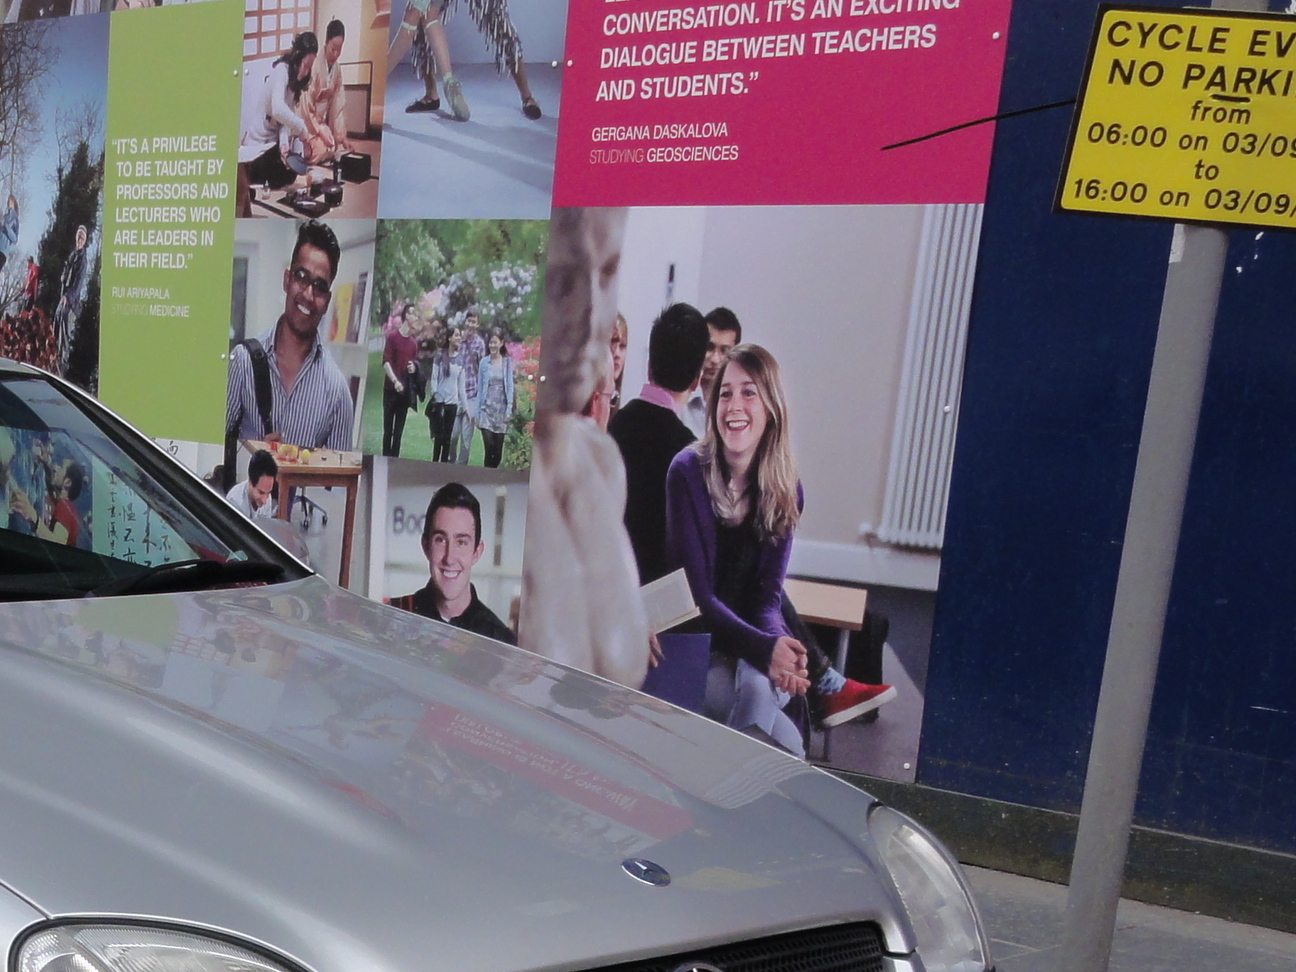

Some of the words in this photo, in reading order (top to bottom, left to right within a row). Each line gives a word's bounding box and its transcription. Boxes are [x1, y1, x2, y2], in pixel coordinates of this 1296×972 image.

[603, 5, 760, 37] CONVERSATION.
[810, 0, 842, 19] AN
[600, 40, 697, 70] DIALOGUE
[702, 33, 805, 63] BETWEEN
[812, 24, 937, 55] TEACHERS
[1107, 20, 1231, 54] CYCLE
[1107, 58, 1164, 87] NO
[595, 79, 636, 102] AND
[640, 71, 759, 100] STUDENTS.”
[1190, 100, 1251, 125] from
[591, 125, 650, 142] GERGANA
[653, 122, 728, 140] DASKALOVA
[1087, 122, 1167, 148] 06:00
[1178, 134, 1208, 152] on
[140, 137, 149, 154] A
[152, 135, 217, 153] PRIVILEGE
[589, 148, 644, 164] STUDYING
[646, 145, 739, 163] GEOSCIENCES
[116, 161, 132, 177] TO
[135, 160, 152, 177] BE
[154, 159, 204, 176] TAUGHT
[207, 158, 224, 175] BY
[1194, 159, 1219, 181] to
[116, 183, 198, 200] PROFESSORS
[201, 182, 229, 199] AND
[1074, 178, 1148, 203] 16:00
[1159, 189, 1190, 207] on
[115, 206, 186, 223] LECTURERS
[190, 206, 221, 223] WHO
[114, 229, 138, 246] ARE
[141, 230, 198, 246] LEADERS
[201, 230, 214, 246] IN
[113, 252, 148, 268] THEIR
[151, 253, 193, 269] FIELD.”
[112, 286, 125, 298] RUI
[126, 287, 170, 299] ARIYAPALA
[149, 304, 190, 317] MEDICINE
